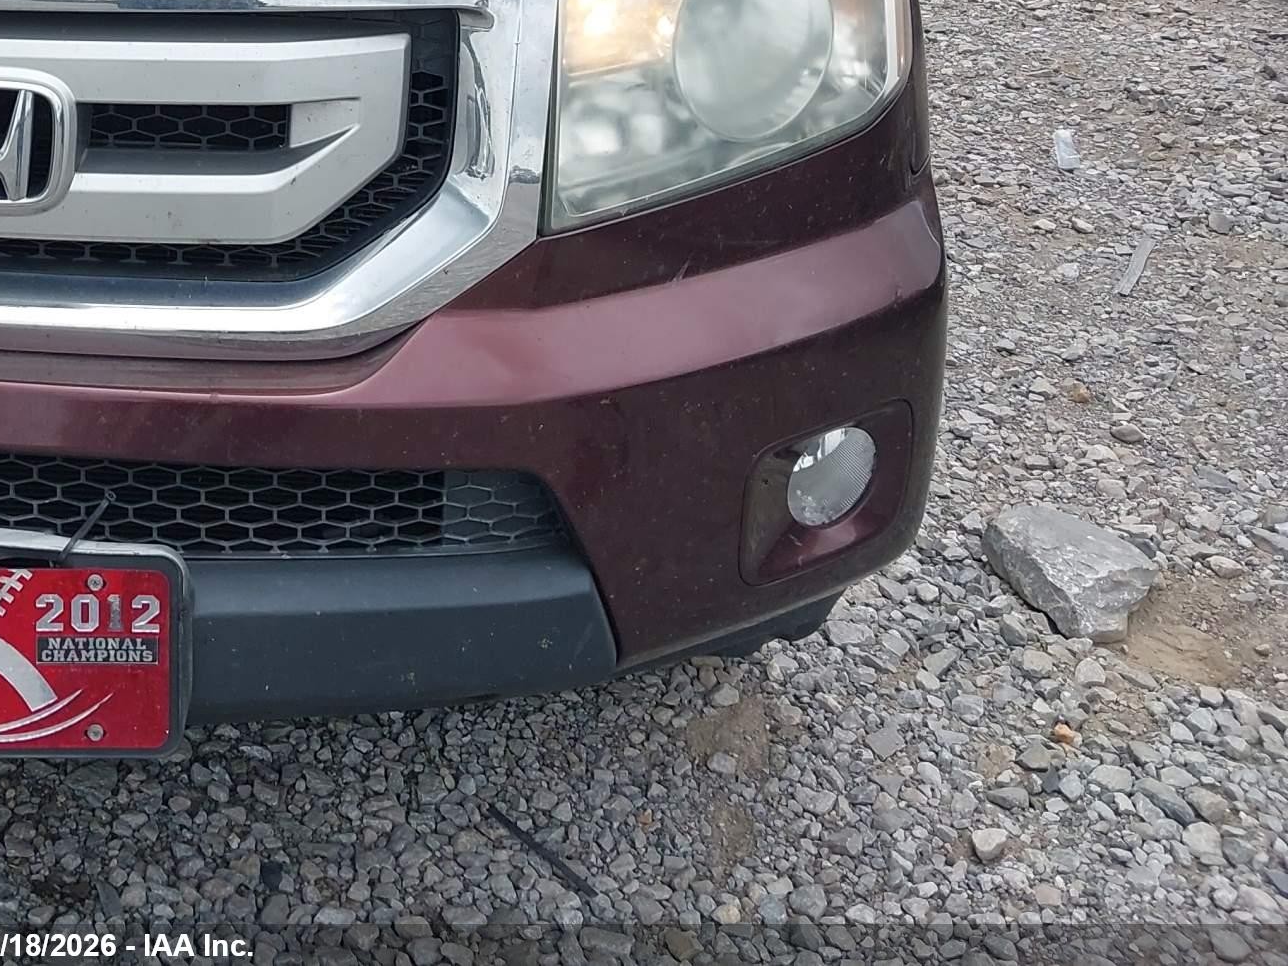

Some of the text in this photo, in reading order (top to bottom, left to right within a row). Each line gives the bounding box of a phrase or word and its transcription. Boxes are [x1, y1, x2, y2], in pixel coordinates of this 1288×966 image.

[35, 593, 161, 633] 2012
[47, 637, 147, 650] NATIONAL
[40, 650, 153, 662] CHAMPIONS
